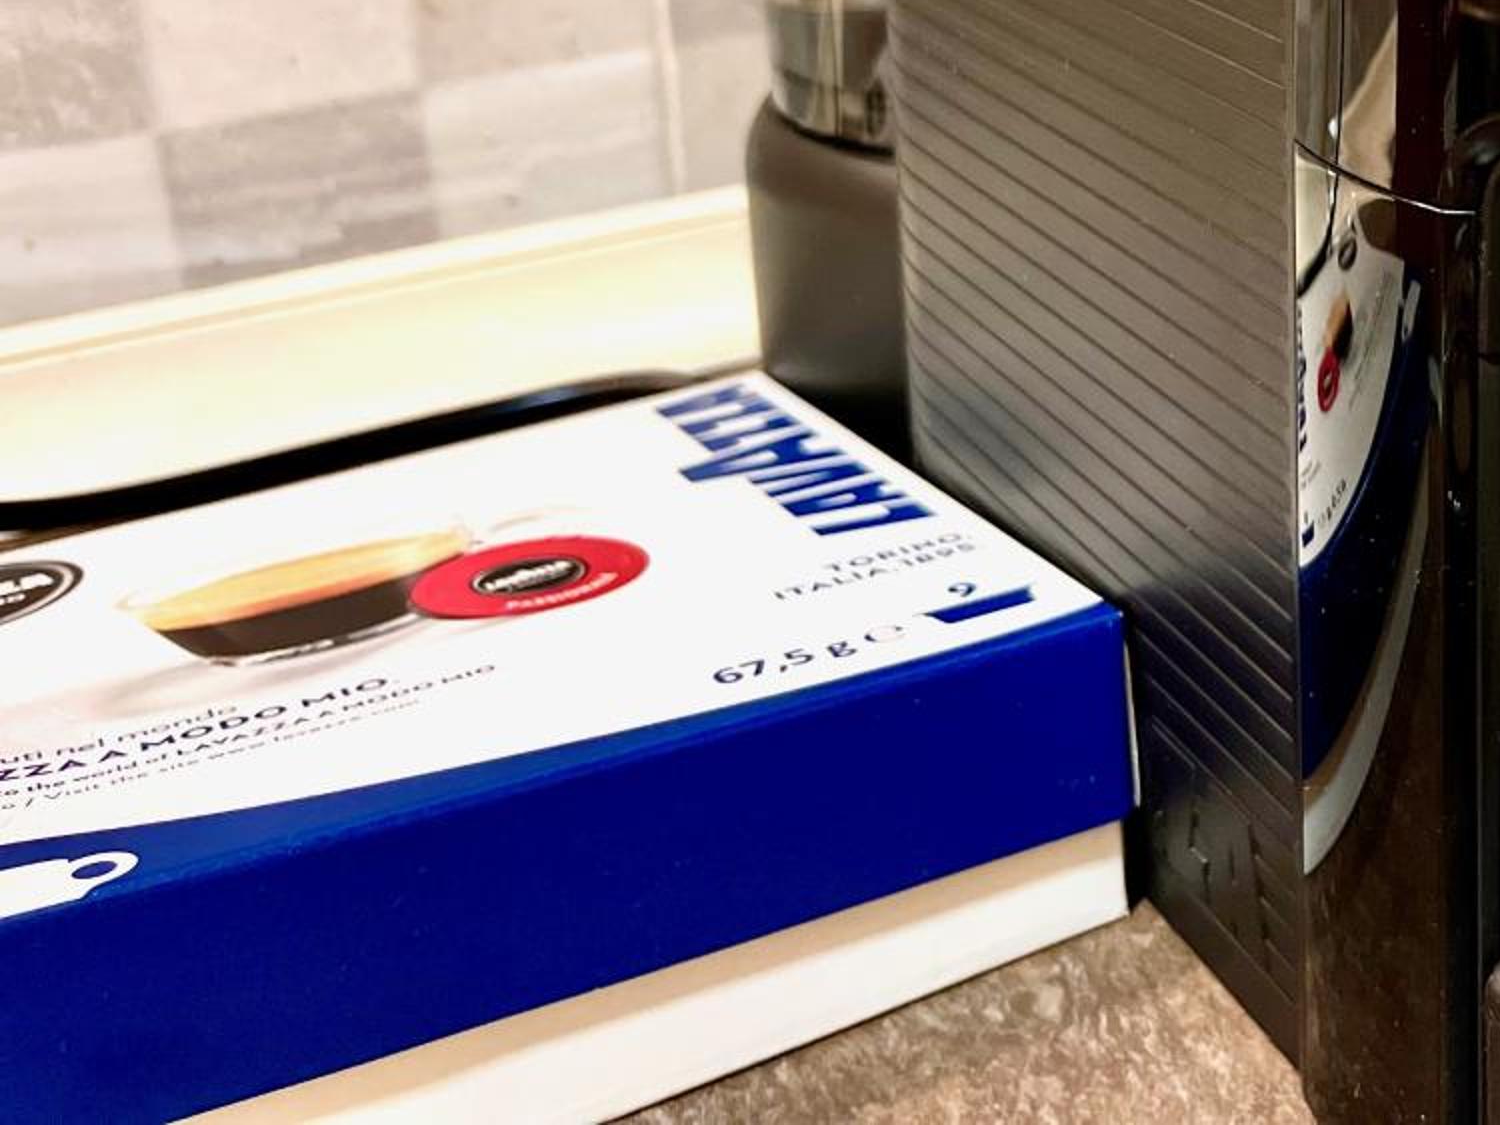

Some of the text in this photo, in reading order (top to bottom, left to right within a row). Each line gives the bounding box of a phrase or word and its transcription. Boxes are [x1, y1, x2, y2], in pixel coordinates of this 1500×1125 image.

[655, 383, 938, 536] LAVAZZA
[713, 649, 814, 685] 67,5
[826, 640, 857, 659] g
[56, 737, 104, 757] nel
[117, 706, 238, 743] mondo
[98, 749, 128, 764] A
[140, 706, 288, 752] MODO
[27, 780, 66, 793] the
[73, 761, 138, 782] world
